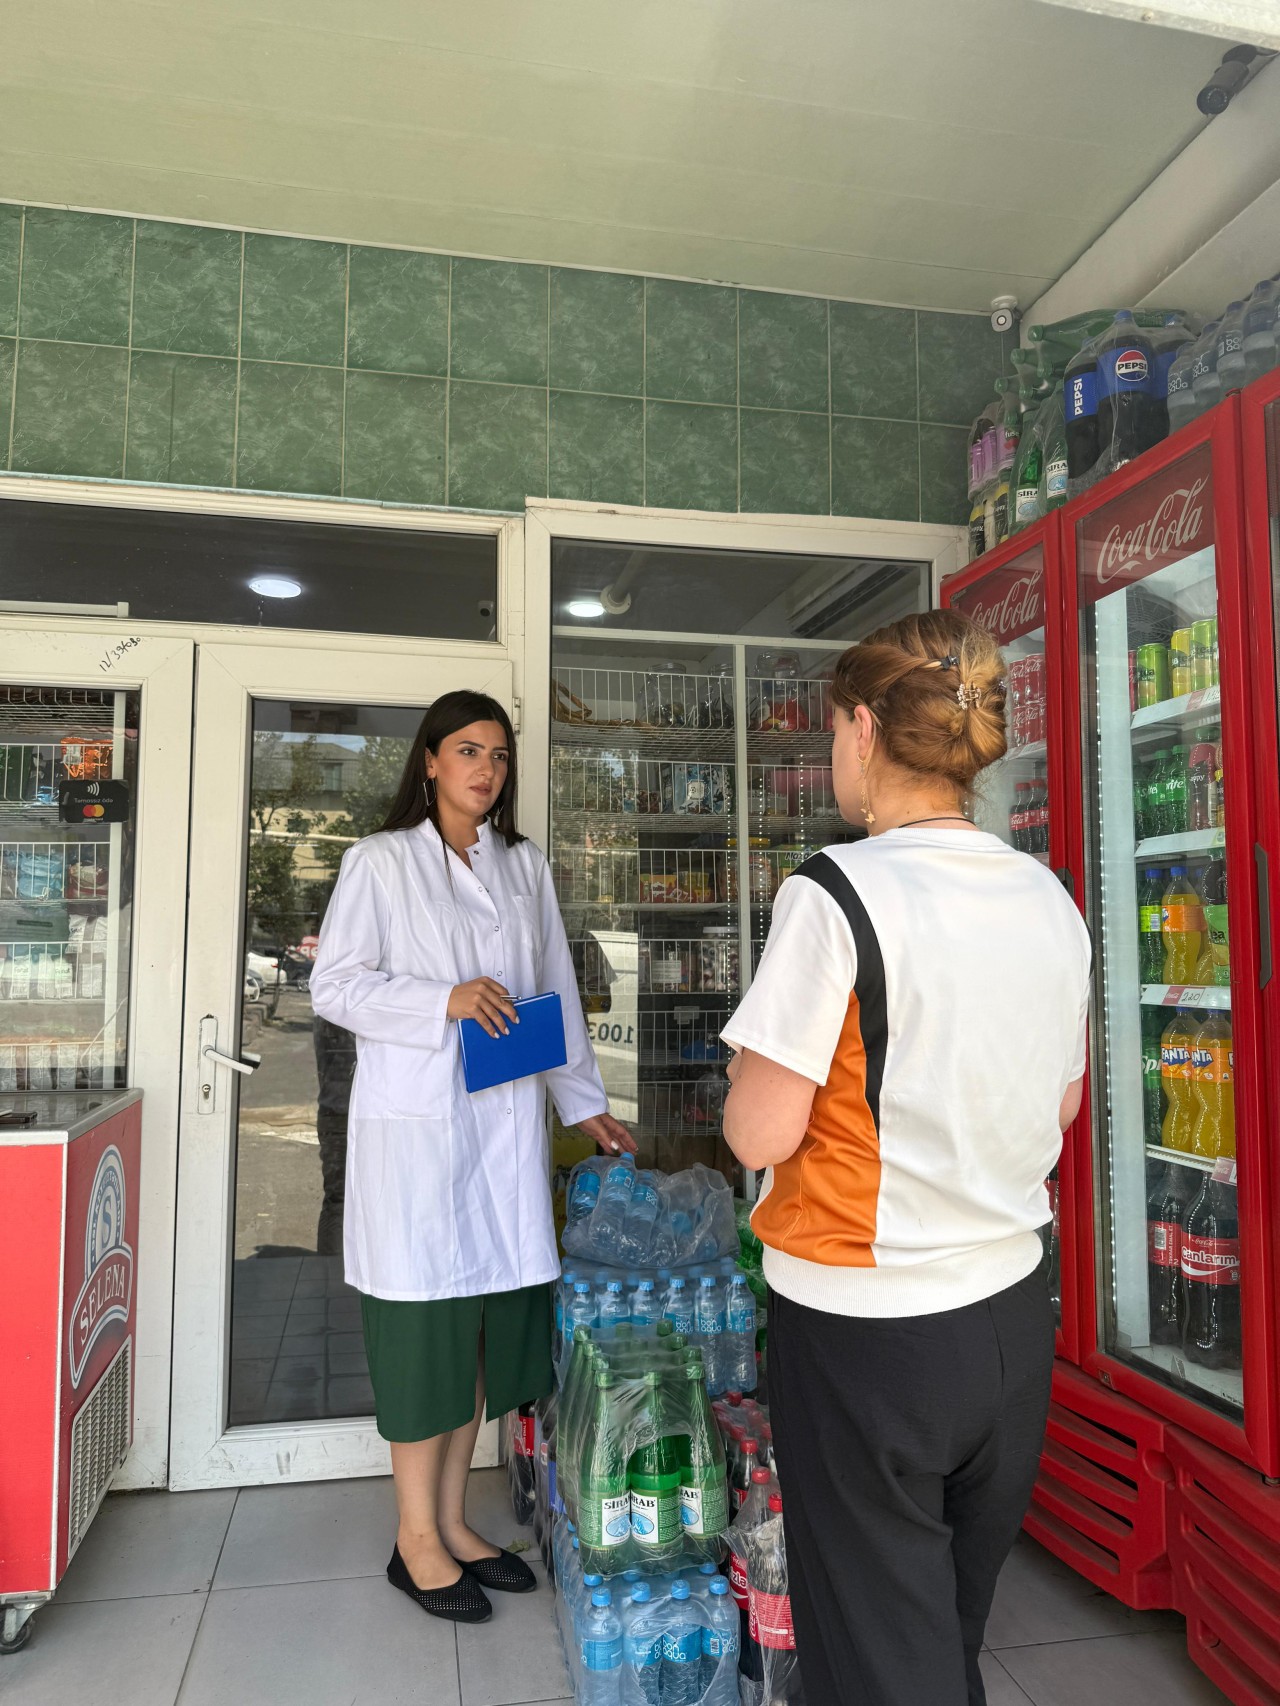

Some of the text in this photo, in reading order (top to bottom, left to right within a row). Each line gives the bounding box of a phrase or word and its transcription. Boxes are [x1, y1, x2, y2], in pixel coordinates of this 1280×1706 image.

[1117, 362, 1147, 371] PEPSI
[1073, 378, 1083, 416] PEPSI
[1047, 461, 1068, 473] SIRA
[1097, 473, 1210, 584] Coca-Cola
[1182, 1246, 1238, 1265] Canlarım
[80, 1263, 126, 1346] SELENA
